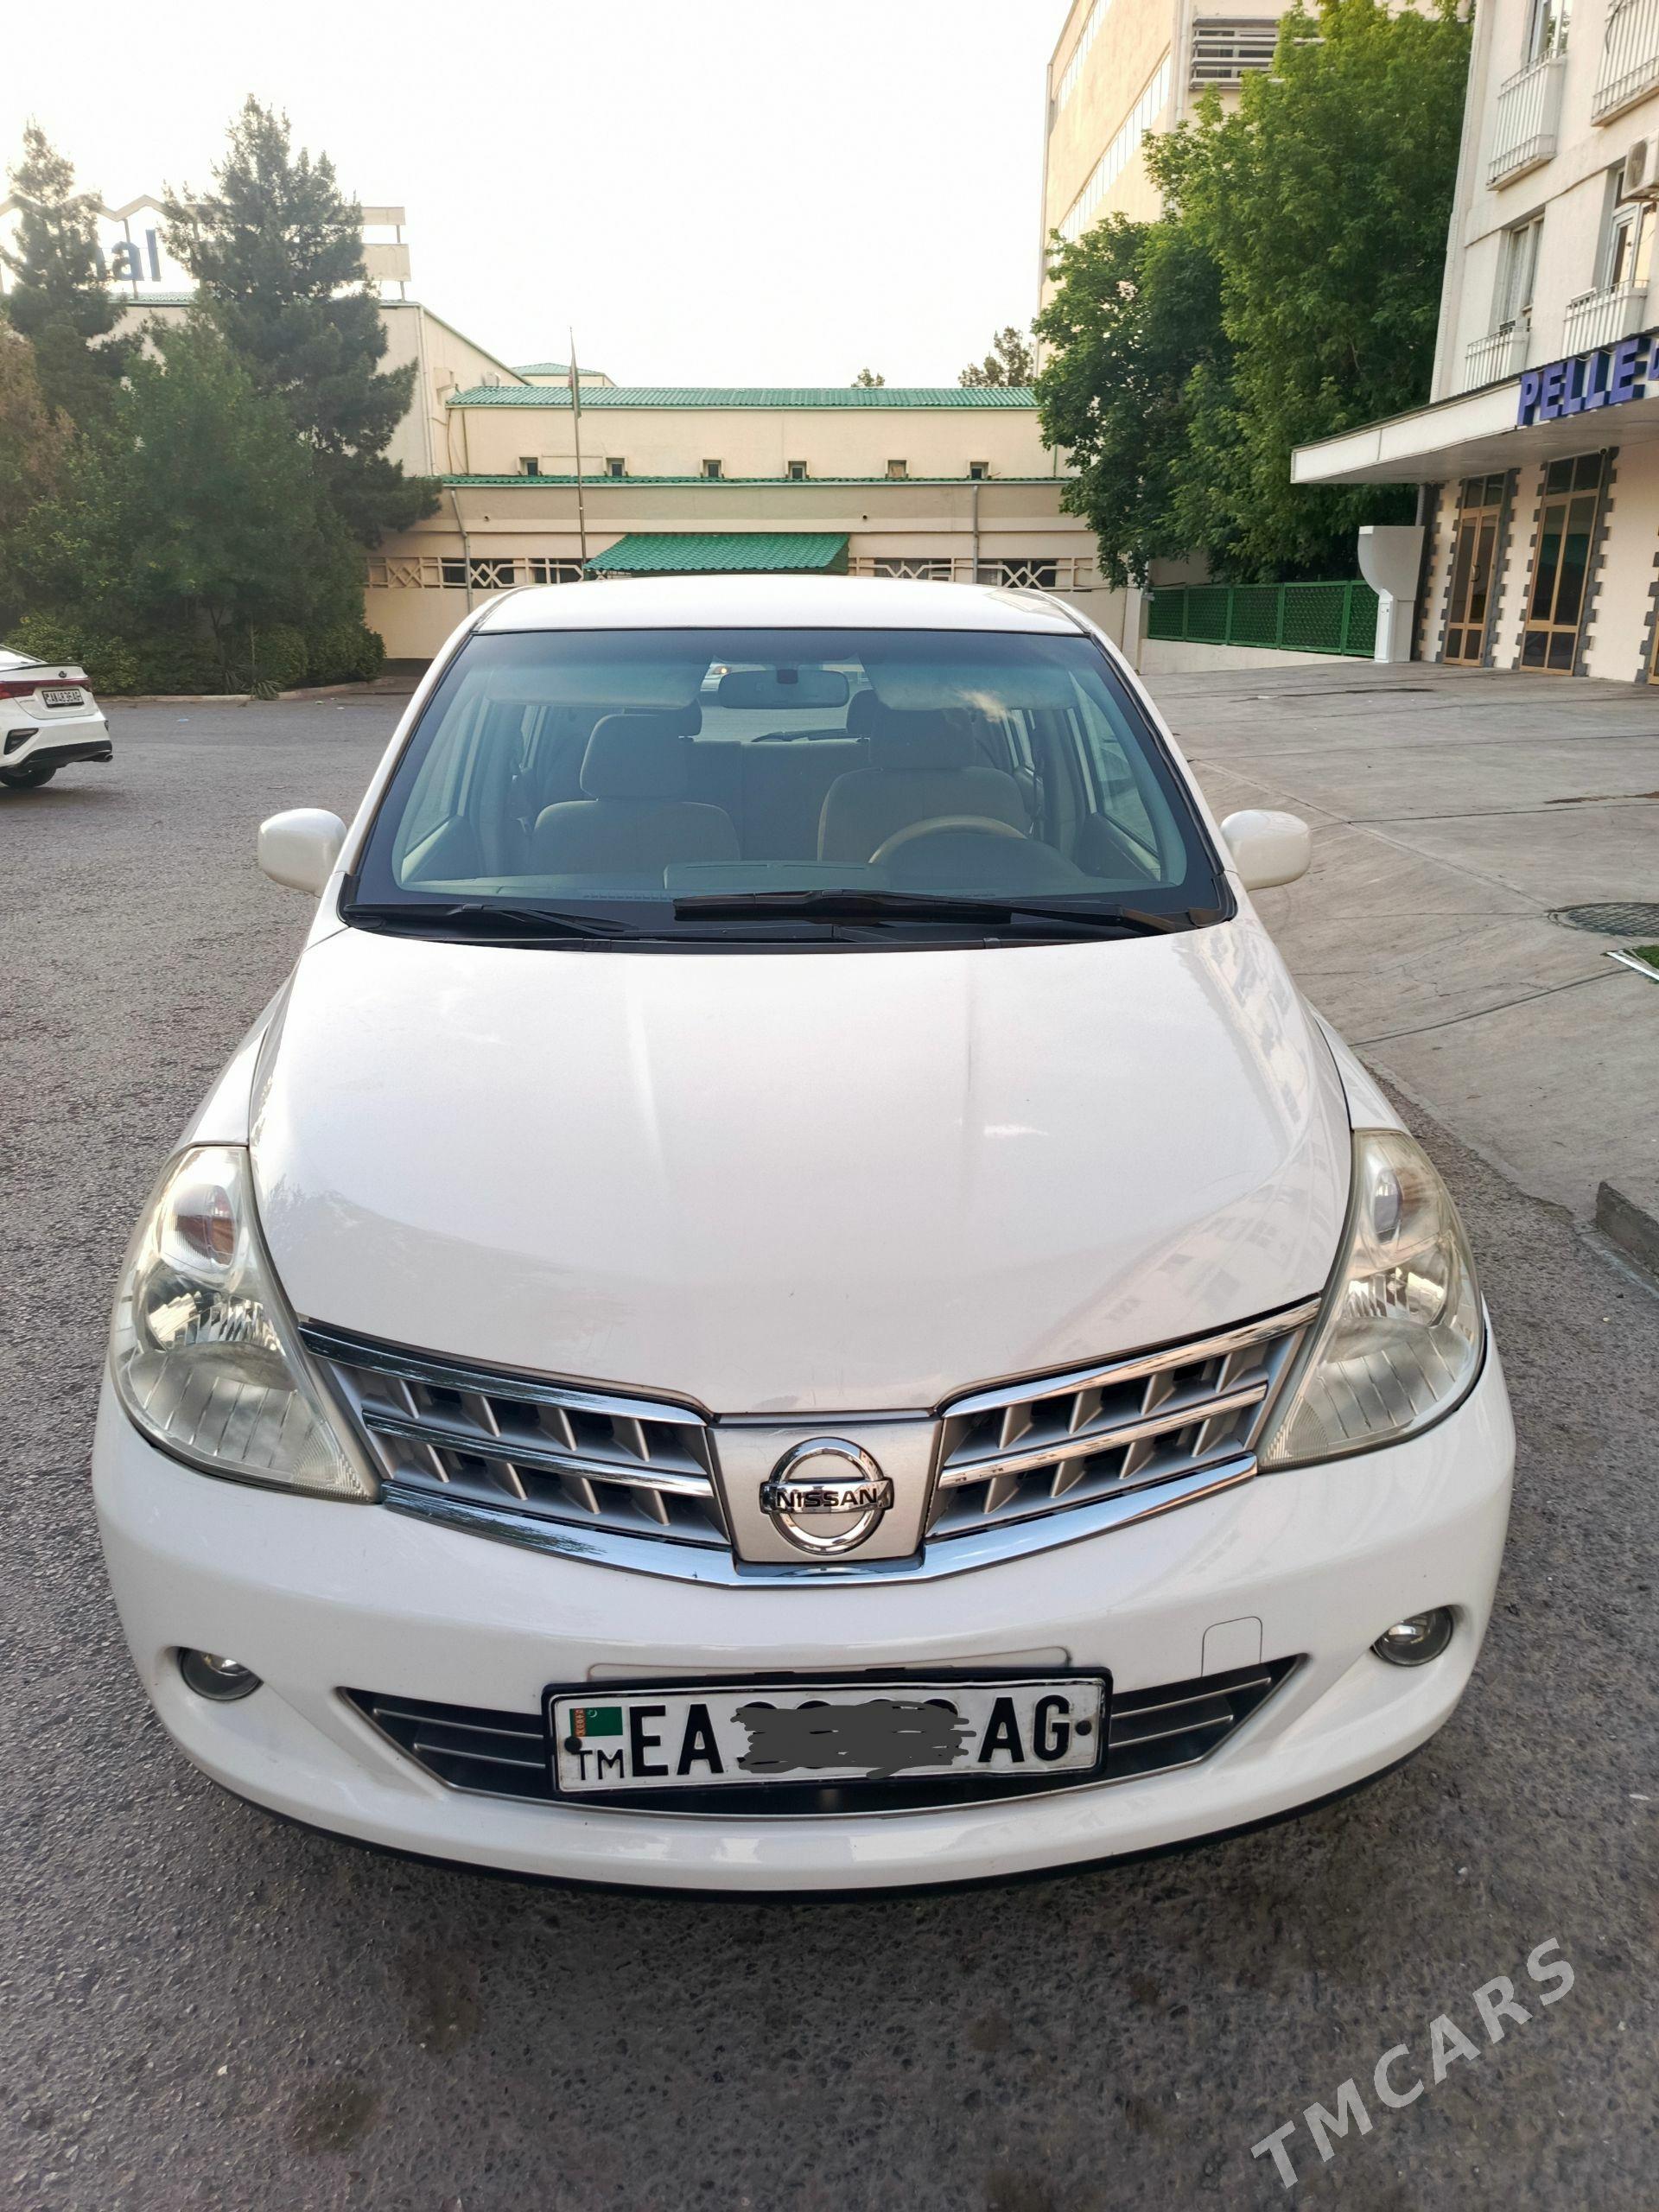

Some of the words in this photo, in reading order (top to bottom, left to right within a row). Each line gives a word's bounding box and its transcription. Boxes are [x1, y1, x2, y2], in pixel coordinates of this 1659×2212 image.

[777, 1488, 879, 1508] NISSAN
[630, 1704, 724, 1777] EA
[977, 1694, 1073, 1764] AG
[576, 1748, 624, 1782] TM
